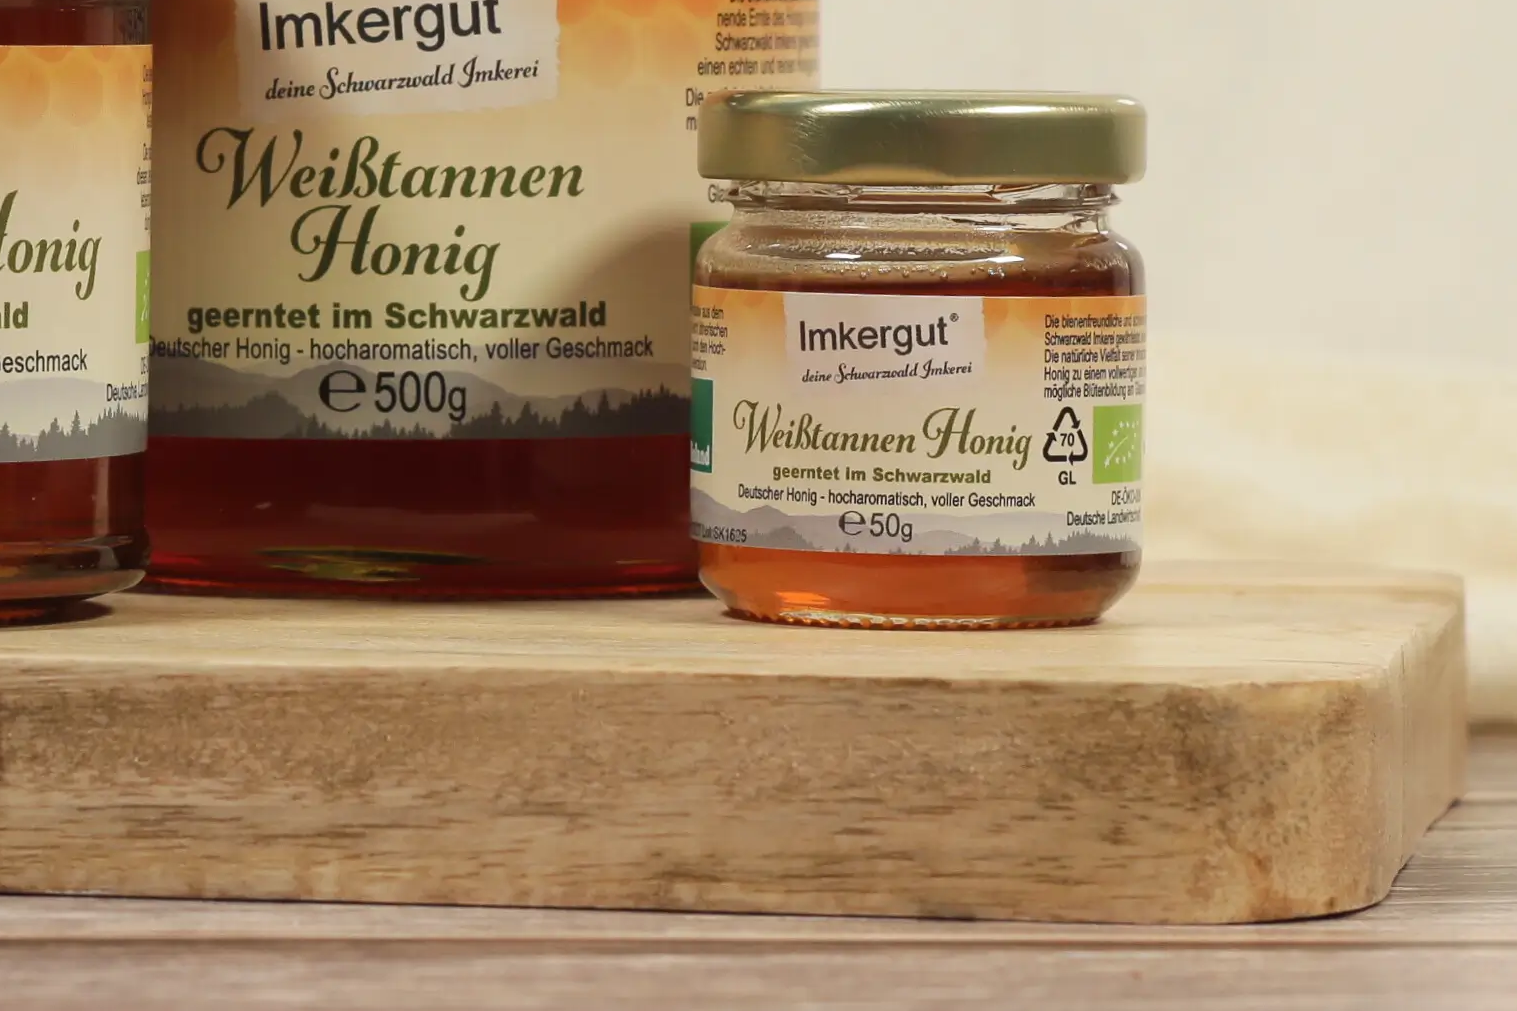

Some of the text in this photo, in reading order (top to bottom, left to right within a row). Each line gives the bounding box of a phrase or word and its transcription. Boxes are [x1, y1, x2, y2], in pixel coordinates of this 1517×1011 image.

[717, 10, 746, 27] nende
[715, 32, 772, 51] Schwarzwald
[698, 58, 725, 75] einen
[729, 58, 758, 75] echten
[265, 55, 539, 100] deine Schwarzwald Imkerei
[686, 88, 704, 106] Die
[195, 126, 584, 210] Weißtannen
[290, 204, 500, 301] Honig
[187, 301, 607, 333] geerntet im Schwarzwald
[1045, 315, 1059, 328] Die
[1045, 332, 1091, 345] Schwarzwald
[1093, 331, 1115, 345] Imkerei
[236, 336, 290, 364] Honig
[310, 336, 478, 363] hocharomatisch,
[485, 336, 541, 360] voller
[546, 335, 653, 360] Geschmack
[1045, 350, 1059, 363] Die
[1061, 349, 1097, 362] natürliche
[802, 359, 972, 384] deine Schwarzwald Imkerei
[1044, 367, 1069, 385] Honig
[1073, 369, 1081, 380] zu
[1084, 366, 1106, 380] einem
[107, 381, 136, 402] Deutsche
[375, 371, 467, 421] 500g
[1044, 384, 1081, 401] mögliche
[1084, 383, 1126, 400] Blütenbildung
[733, 399, 1033, 470] Weißtannen Honig
[1060, 433, 1075, 446] 70
[772, 466, 991, 485] geerntet im Schwarzwald
[1058, 471, 1076, 485] GL
[738, 484, 783, 502] Deutscher
[787, 488, 818, 507] Honig
[828, 490, 926, 508] hocharomatisch,
[931, 492, 963, 506] voller
[968, 492, 1035, 508] Geschmack
[869, 513, 913, 542] 50g
[1067, 510, 1105, 526] Deutsche
